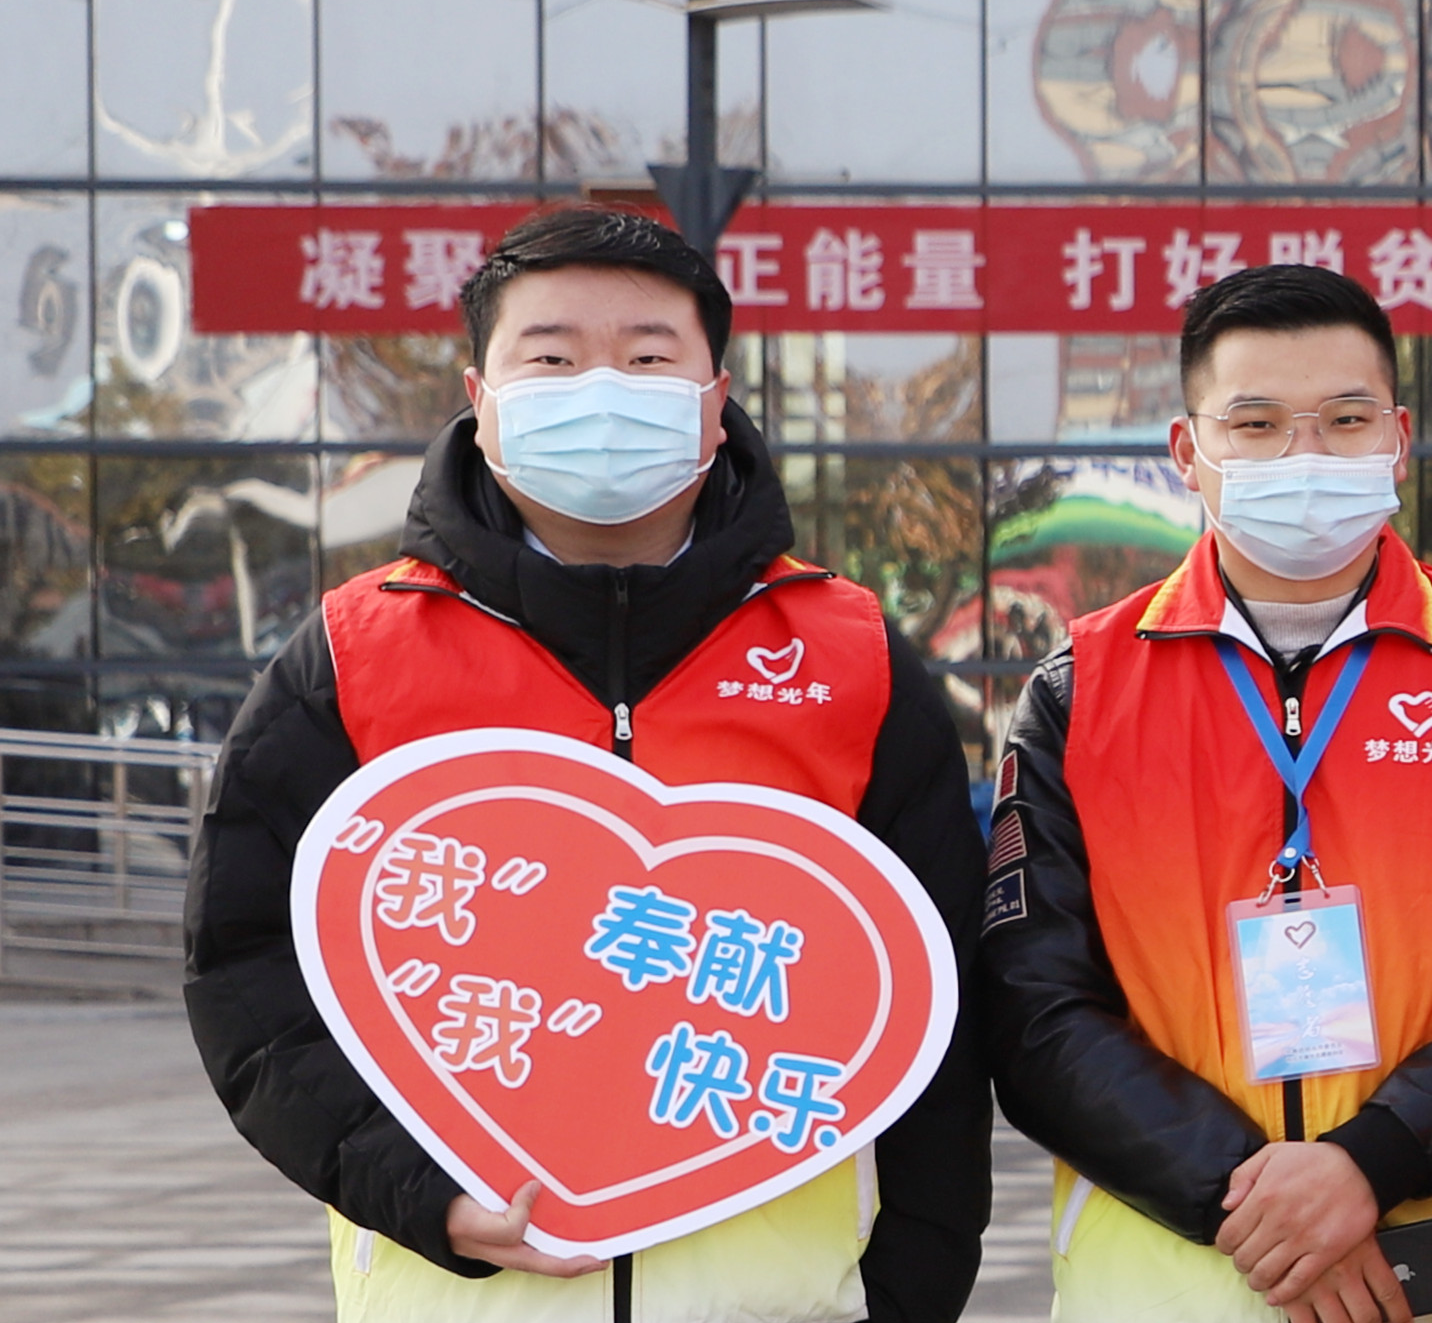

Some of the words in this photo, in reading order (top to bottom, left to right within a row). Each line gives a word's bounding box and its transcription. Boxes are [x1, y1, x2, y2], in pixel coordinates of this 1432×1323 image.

[299, 227, 987, 312] 凝聚正能量
[716, 679, 834, 707] 梦想光年
[584, 884, 804, 1022] 奉献
[646, 1025, 846, 1150] 快乐
